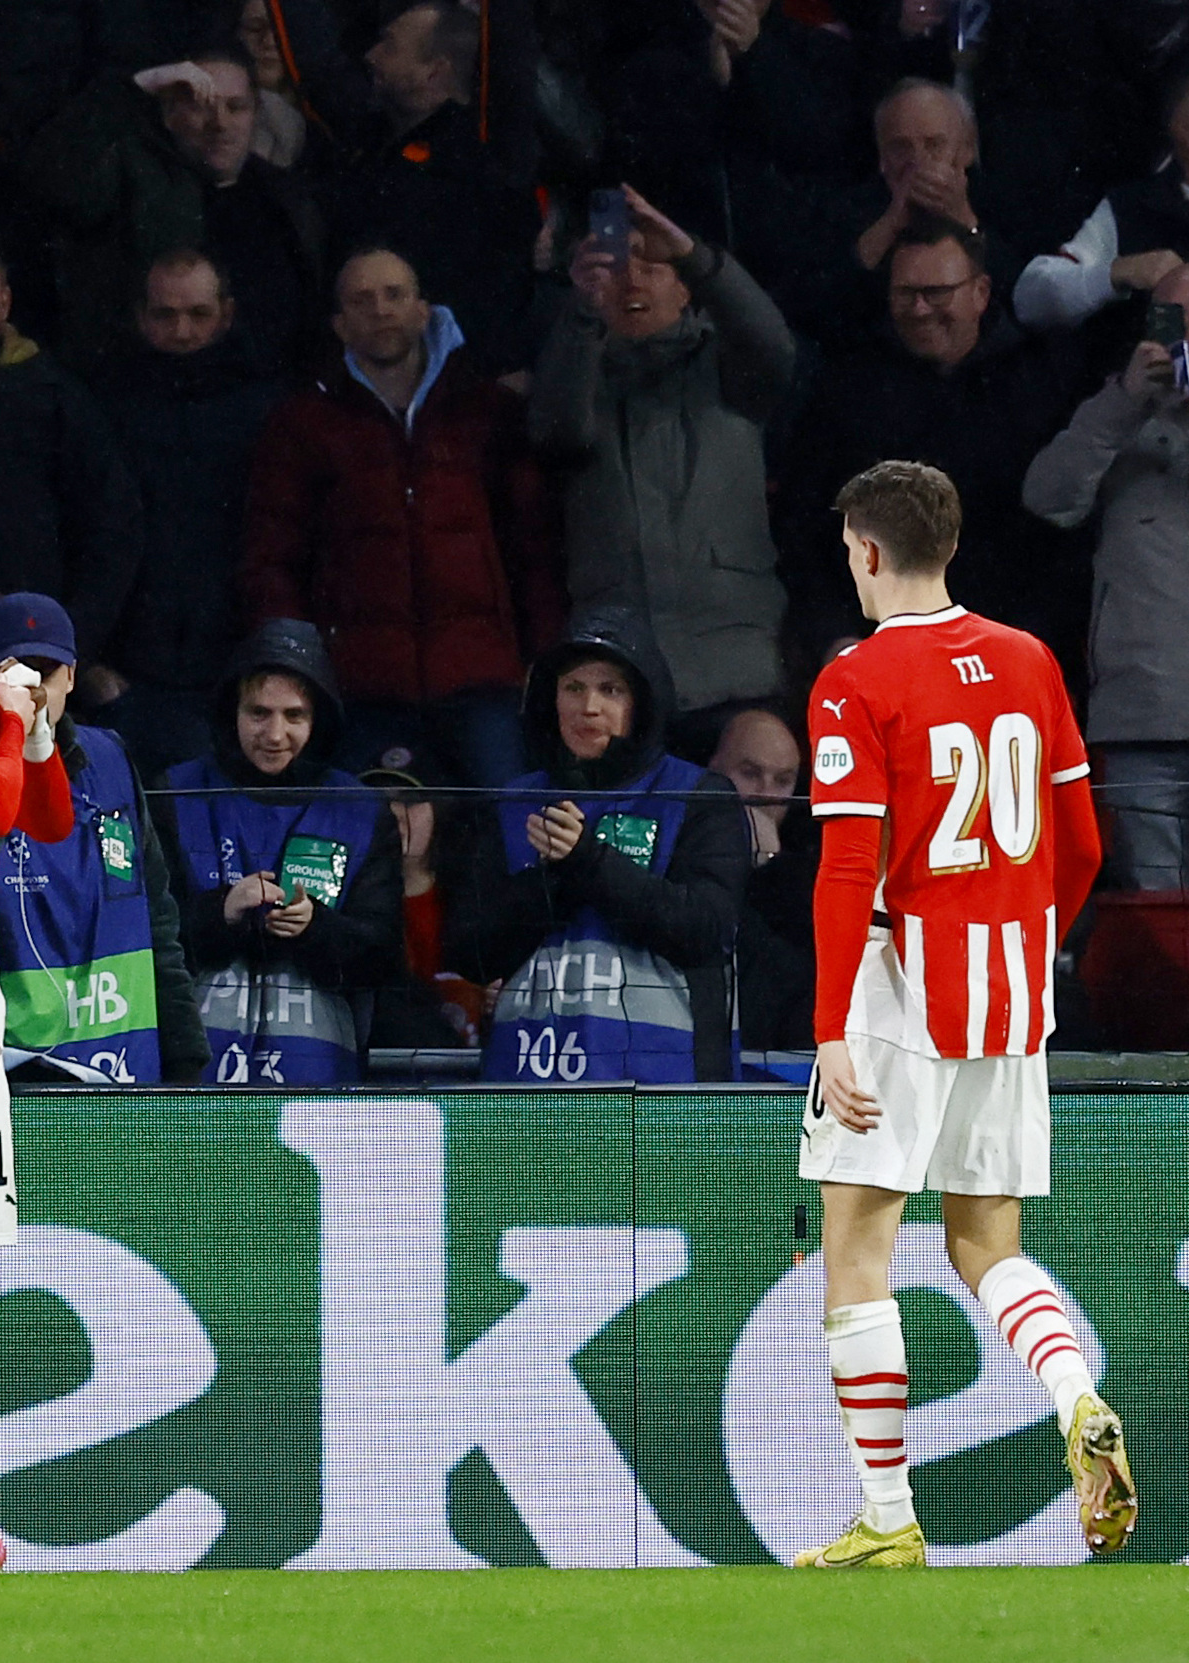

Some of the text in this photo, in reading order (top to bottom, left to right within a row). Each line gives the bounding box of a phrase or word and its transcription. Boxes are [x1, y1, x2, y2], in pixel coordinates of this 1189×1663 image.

[950, 654, 995, 685] TIL
[927, 711, 1043, 877] 20
[65, 971, 129, 1029] HB
